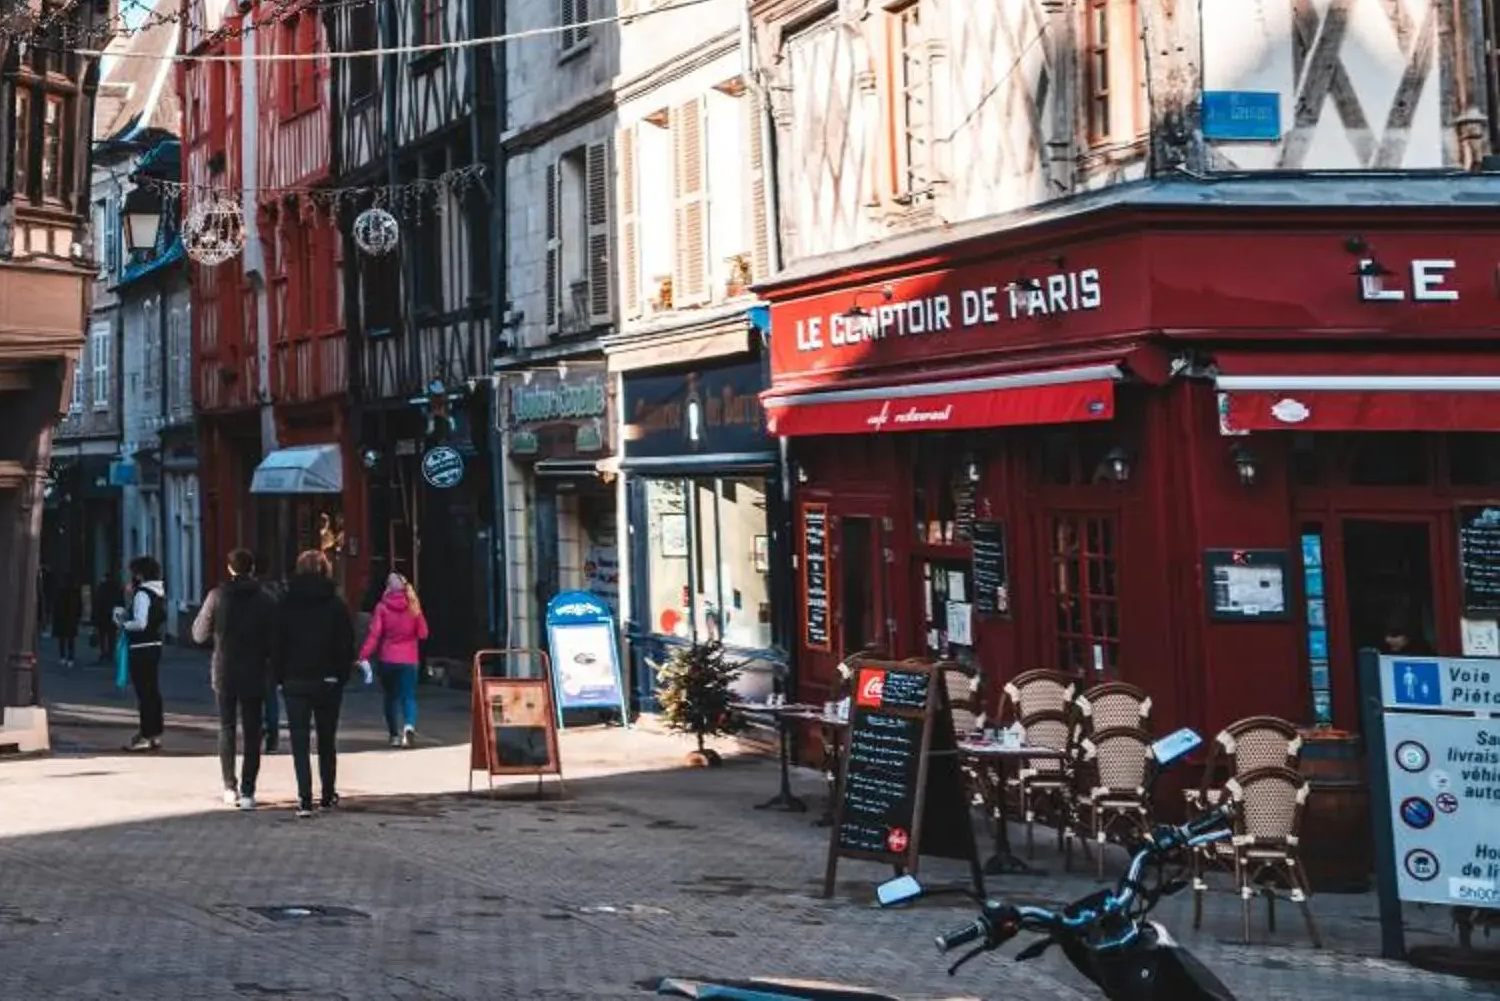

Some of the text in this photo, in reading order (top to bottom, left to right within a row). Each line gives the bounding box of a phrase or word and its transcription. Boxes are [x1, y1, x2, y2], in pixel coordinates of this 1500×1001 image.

[1360, 259, 1460, 300] LE
[795, 268, 1101, 351] LE COMPTOIR DE PARIS
[1449, 667, 1490, 684] Voie
[1461, 862, 1500, 880] de li
